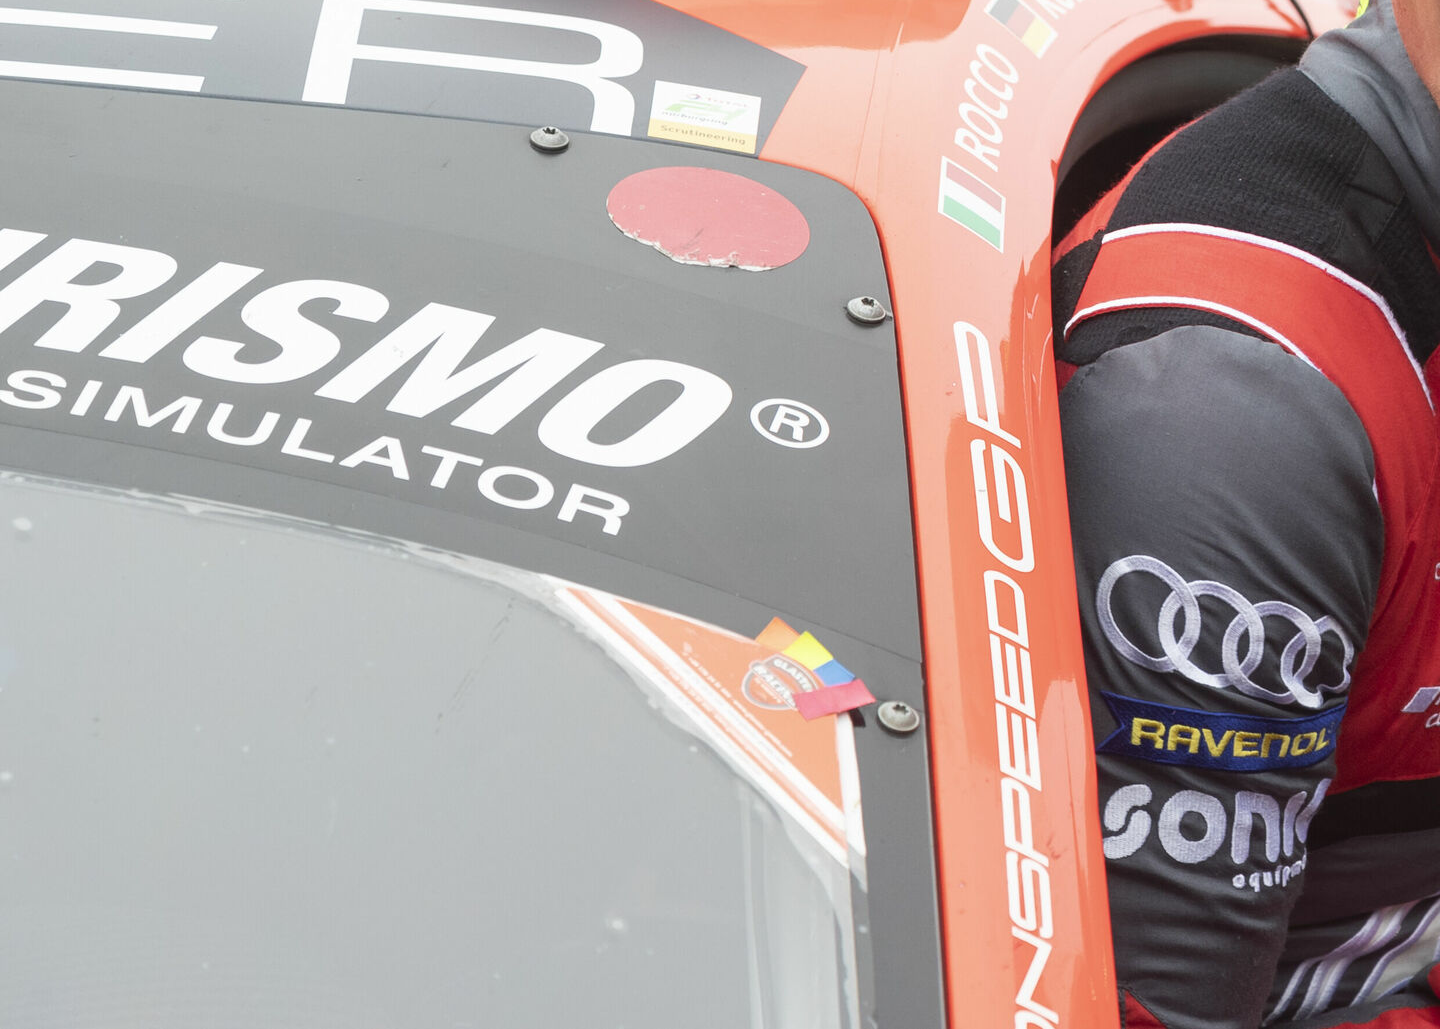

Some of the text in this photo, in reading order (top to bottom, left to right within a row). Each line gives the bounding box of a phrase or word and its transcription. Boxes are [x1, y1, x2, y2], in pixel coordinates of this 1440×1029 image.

[954, 43, 1019, 172] ROCCO
[0, 369, 631, 536] SIMULATOR
[956, 321, 1059, 1029] NSPEEDGP
[1130, 716, 1330, 759] RAVENOL
